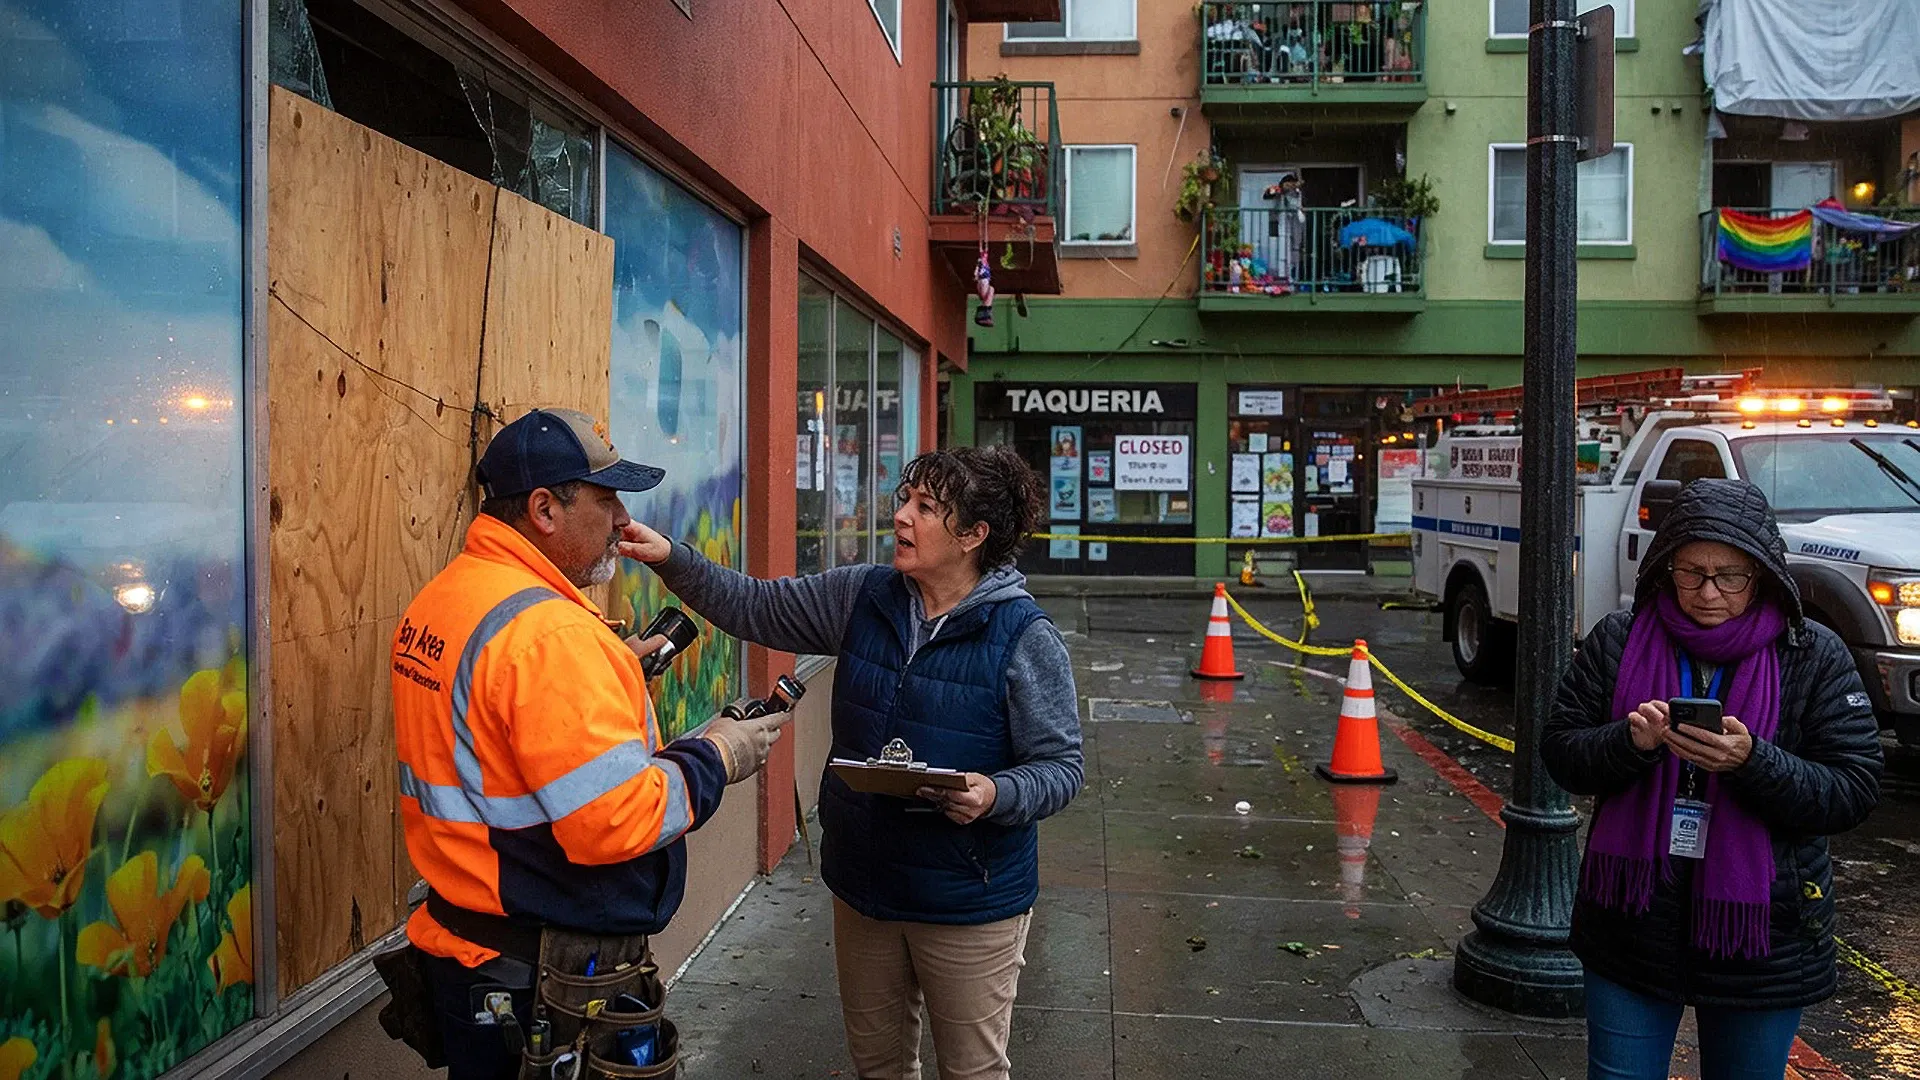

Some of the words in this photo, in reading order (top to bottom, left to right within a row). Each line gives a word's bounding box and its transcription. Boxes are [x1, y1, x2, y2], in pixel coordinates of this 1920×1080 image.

[1006, 389, 1164, 413] TAQUERIA
[1119, 440, 1183, 455] CLOSED
[415, 625, 445, 661] Area
